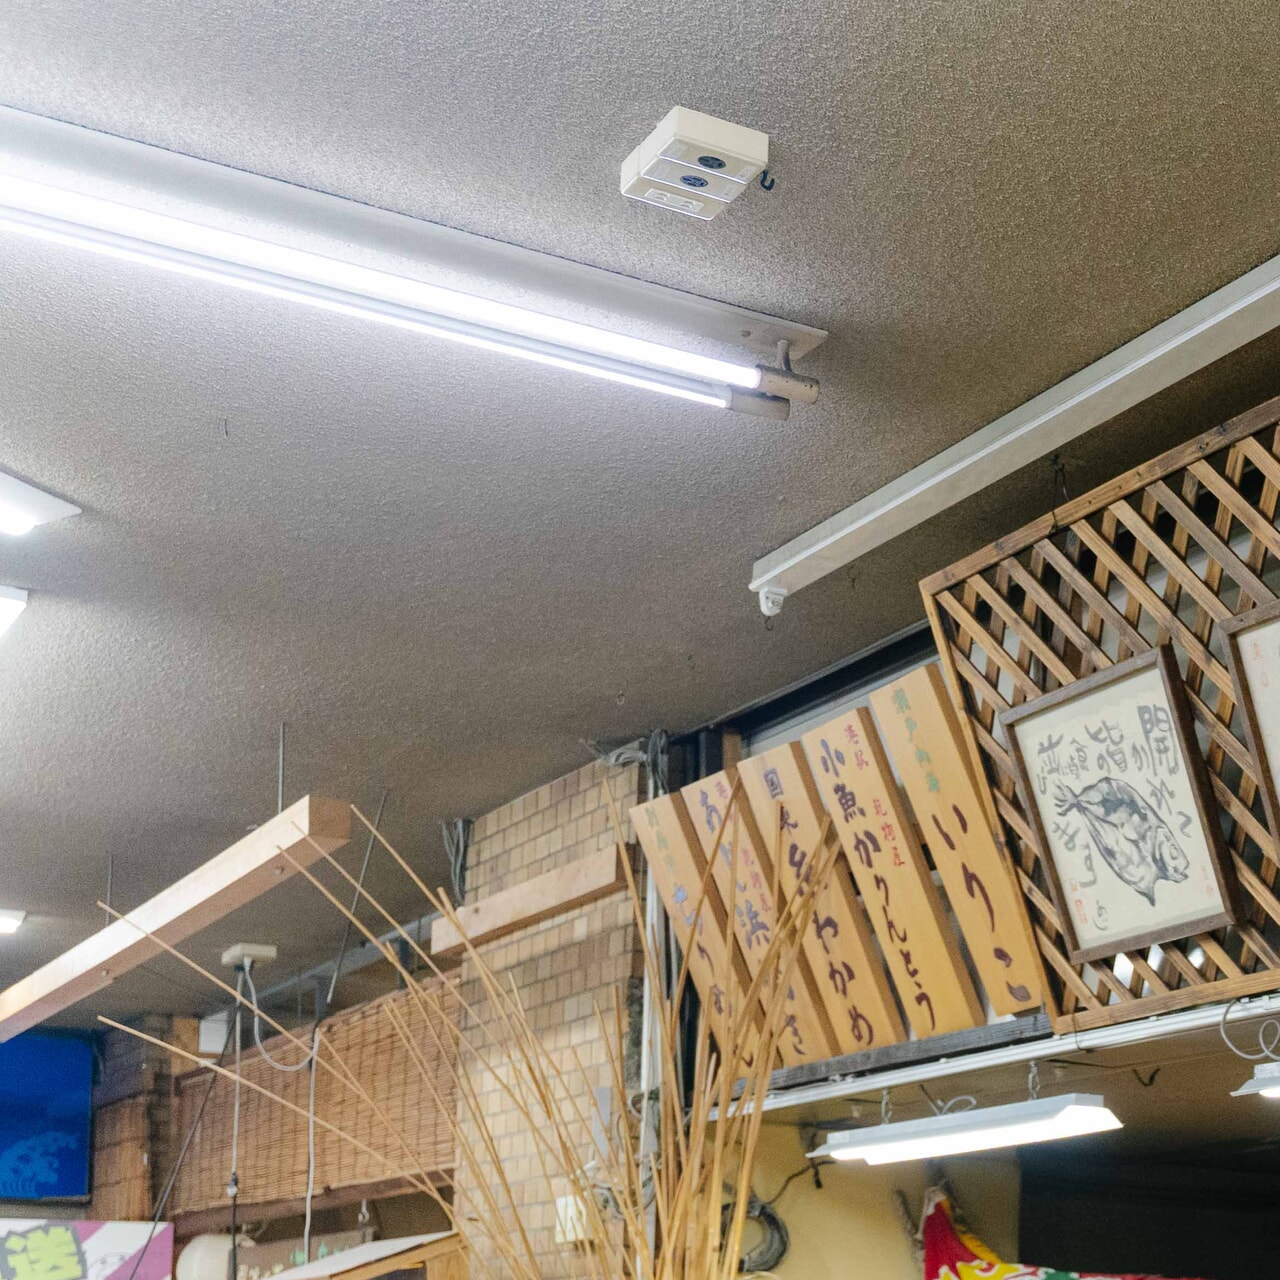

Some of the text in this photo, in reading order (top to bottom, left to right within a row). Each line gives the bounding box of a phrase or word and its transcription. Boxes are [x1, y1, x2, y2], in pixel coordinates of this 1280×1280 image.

[819, 738, 937, 1032] 小魚かりんとう
[930, 802, 1031, 1003] いりこ
